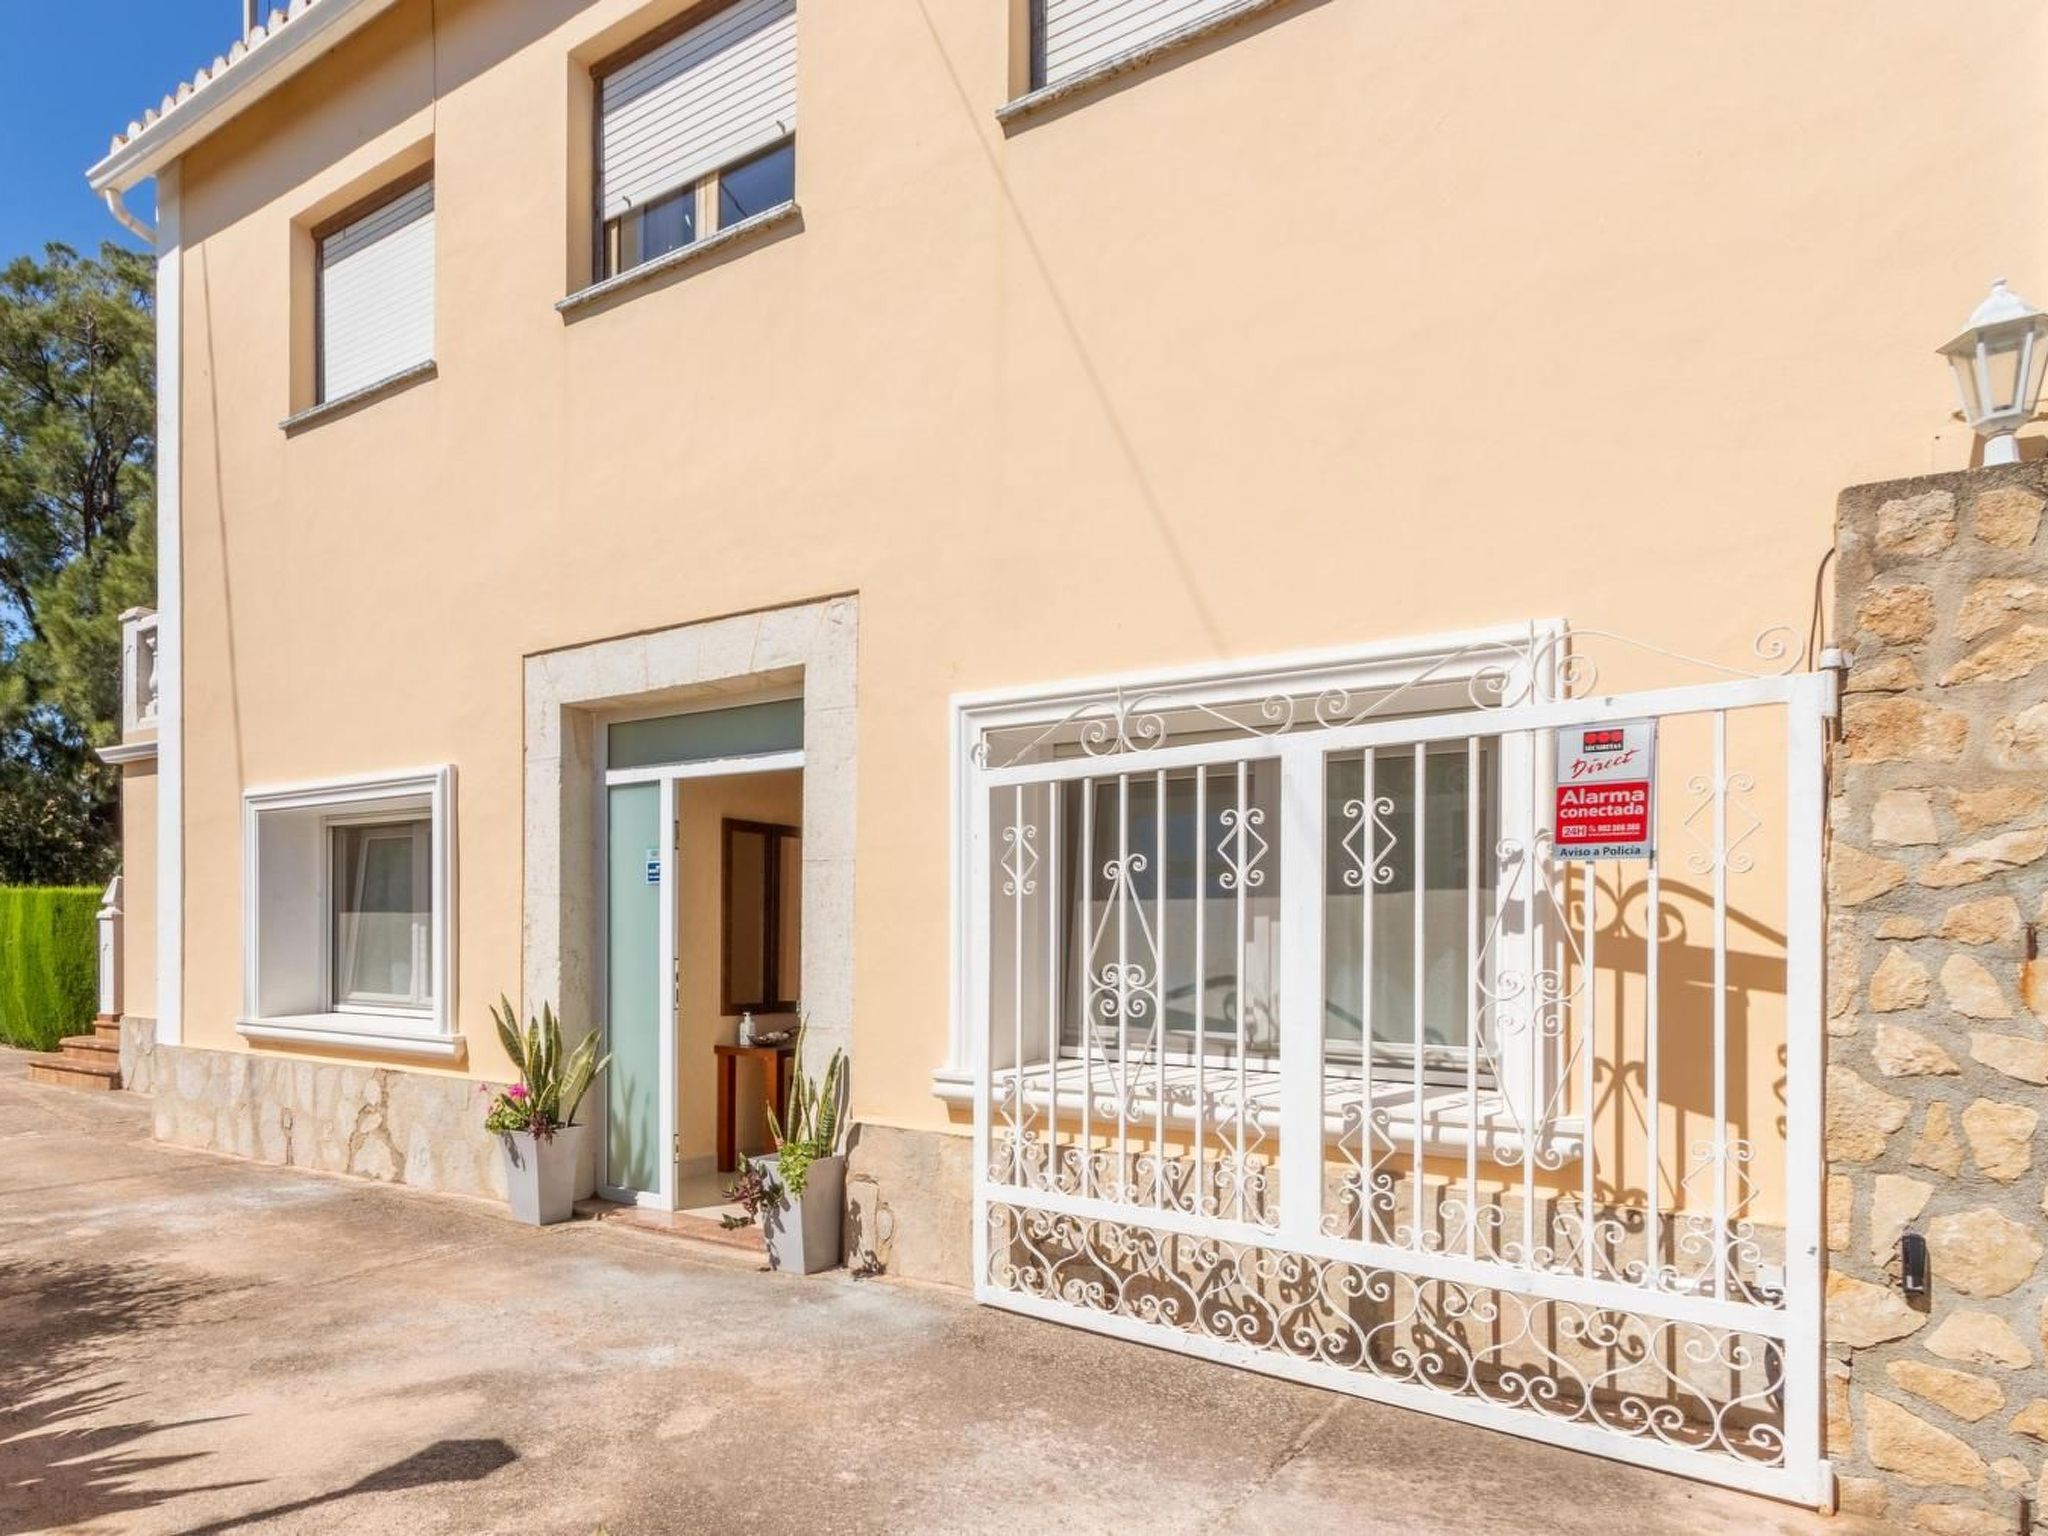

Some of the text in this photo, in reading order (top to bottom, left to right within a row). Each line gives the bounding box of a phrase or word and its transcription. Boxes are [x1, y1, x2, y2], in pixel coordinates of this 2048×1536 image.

[1571, 748, 1640, 779] Direct
[1560, 789, 1645, 806] Alarma
[1560, 802, 1644, 818] conectada
[1564, 827, 1585, 836] 24H
[1560, 847, 1590, 857] Aviso
